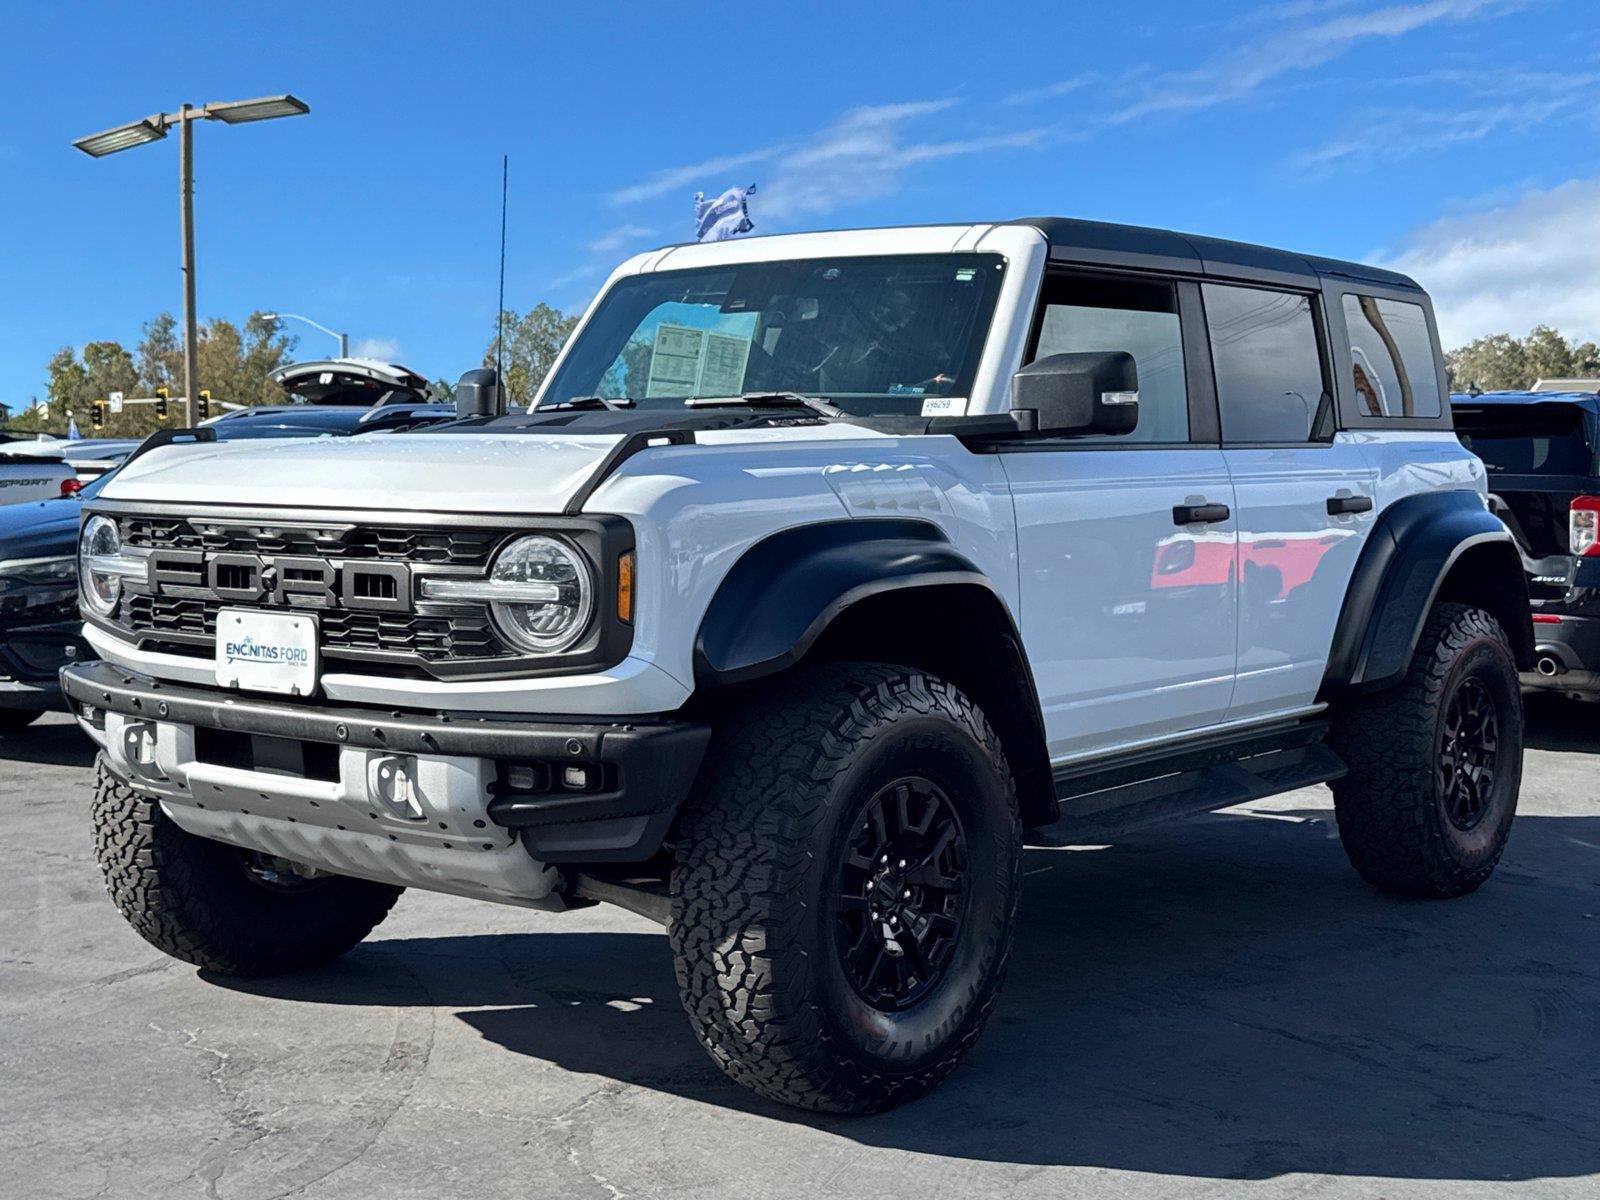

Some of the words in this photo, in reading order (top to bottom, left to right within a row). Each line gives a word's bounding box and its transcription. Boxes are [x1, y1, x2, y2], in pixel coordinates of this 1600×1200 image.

[149, 549, 412, 612] FORD
[226, 641, 278, 659] ENCINITAS
[280, 647, 307, 662] FORD
